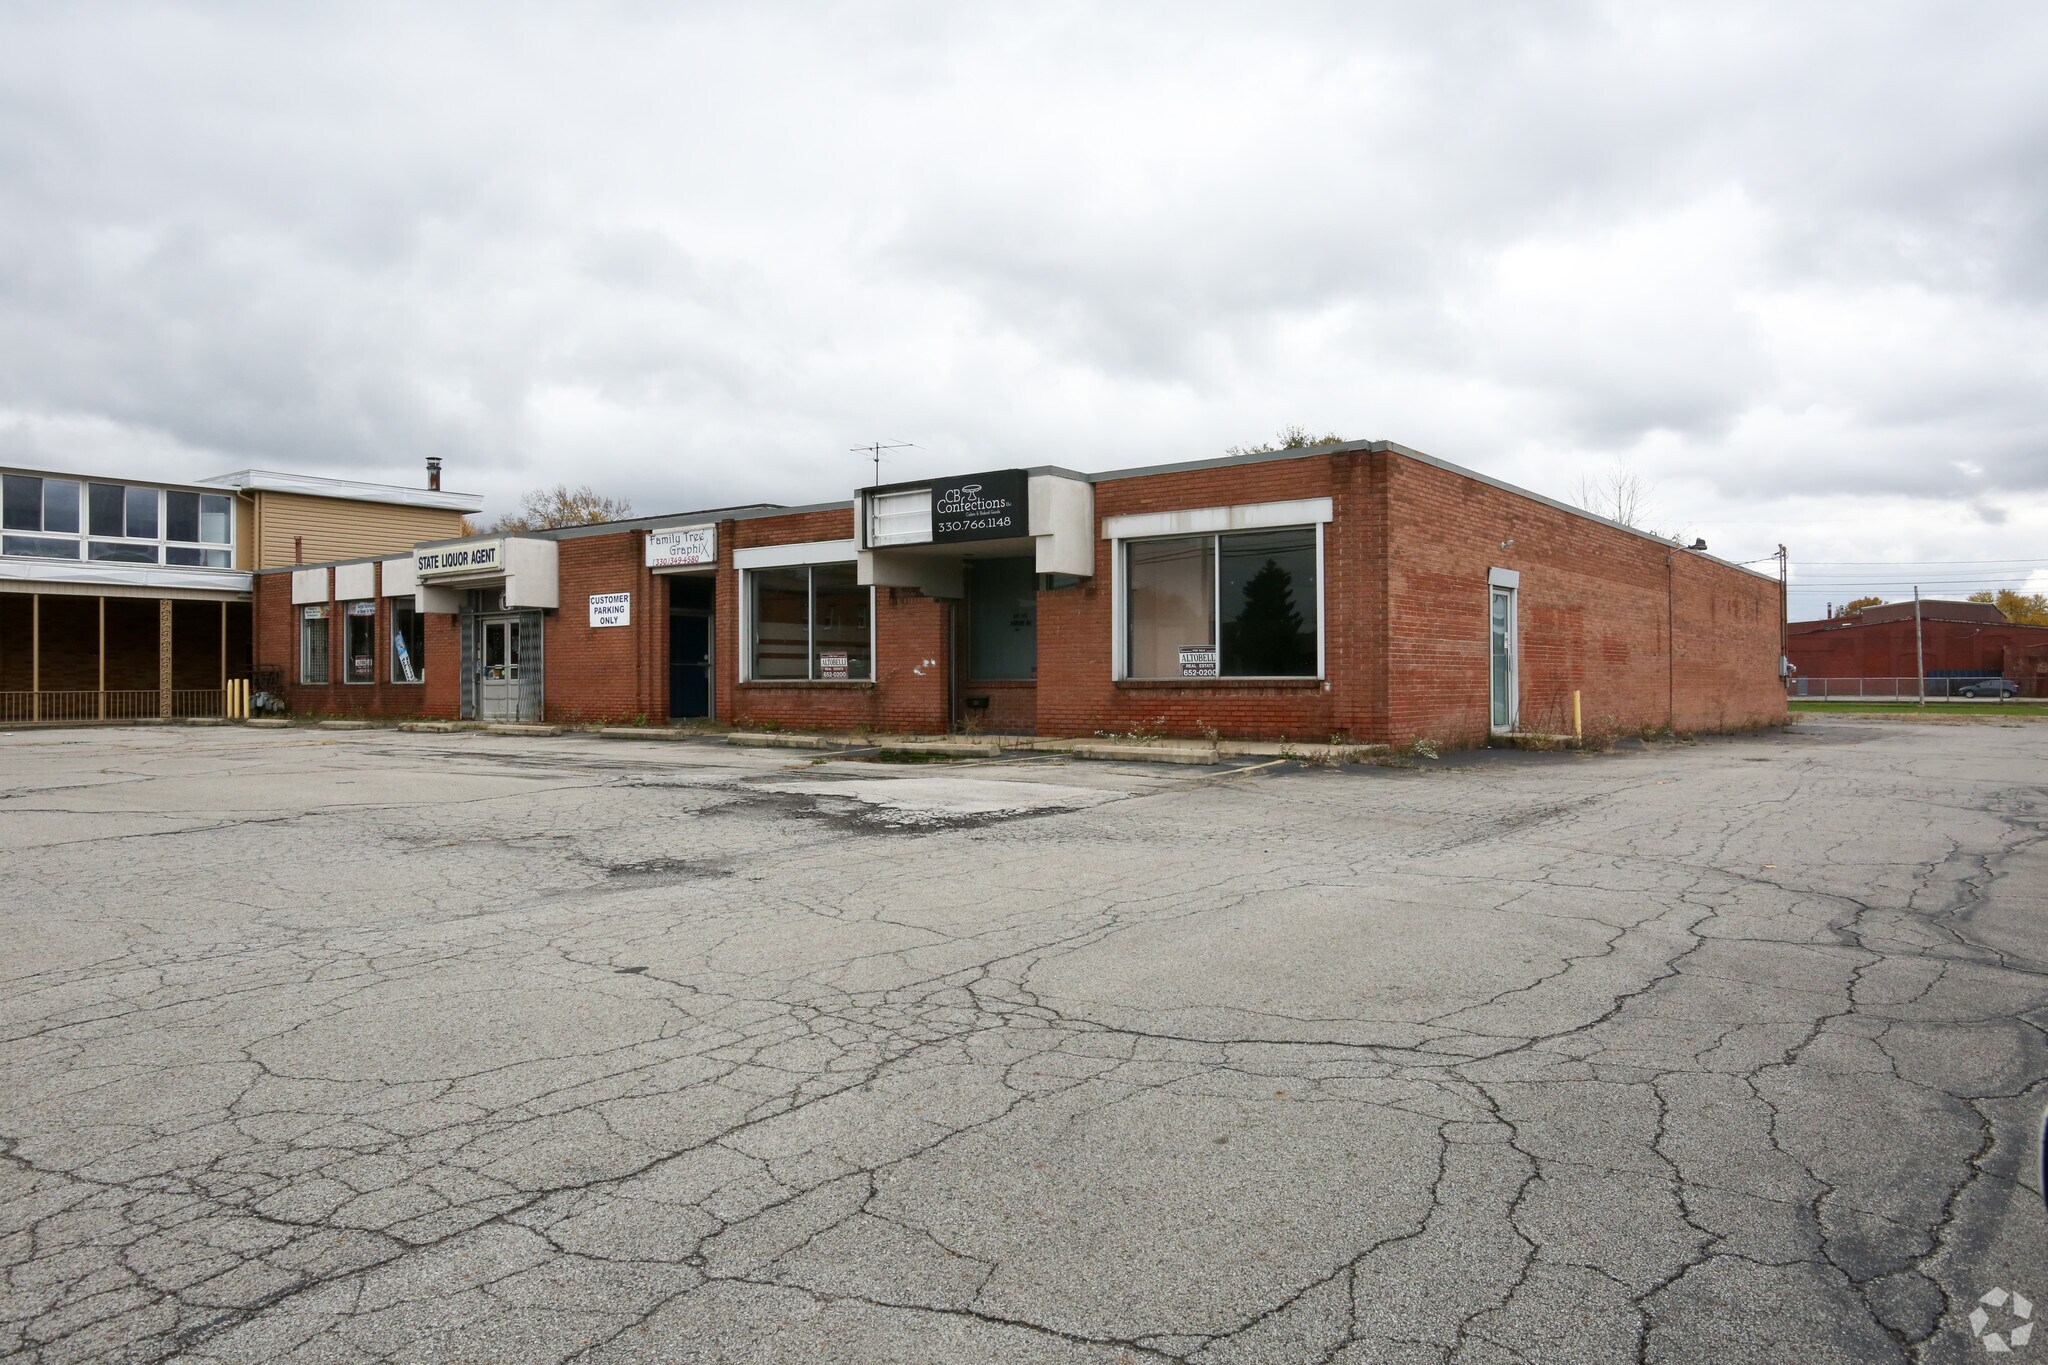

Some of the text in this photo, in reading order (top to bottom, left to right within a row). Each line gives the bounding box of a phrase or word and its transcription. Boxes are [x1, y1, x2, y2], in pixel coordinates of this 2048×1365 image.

[944, 488, 960, 503] CB
[937, 496, 1006, 514] Confections
[938, 516, 1012, 532] 330.766.1148
[650, 529, 704, 546] Family Tree
[418, 548, 495, 570] STATE LIQUOR AGENT
[590, 594, 628, 604] CUSTOMER
[594, 606, 624, 614] PARKING
[600, 616, 618, 624] ONLY
[1182, 654, 1216, 662] ALTOBELL
